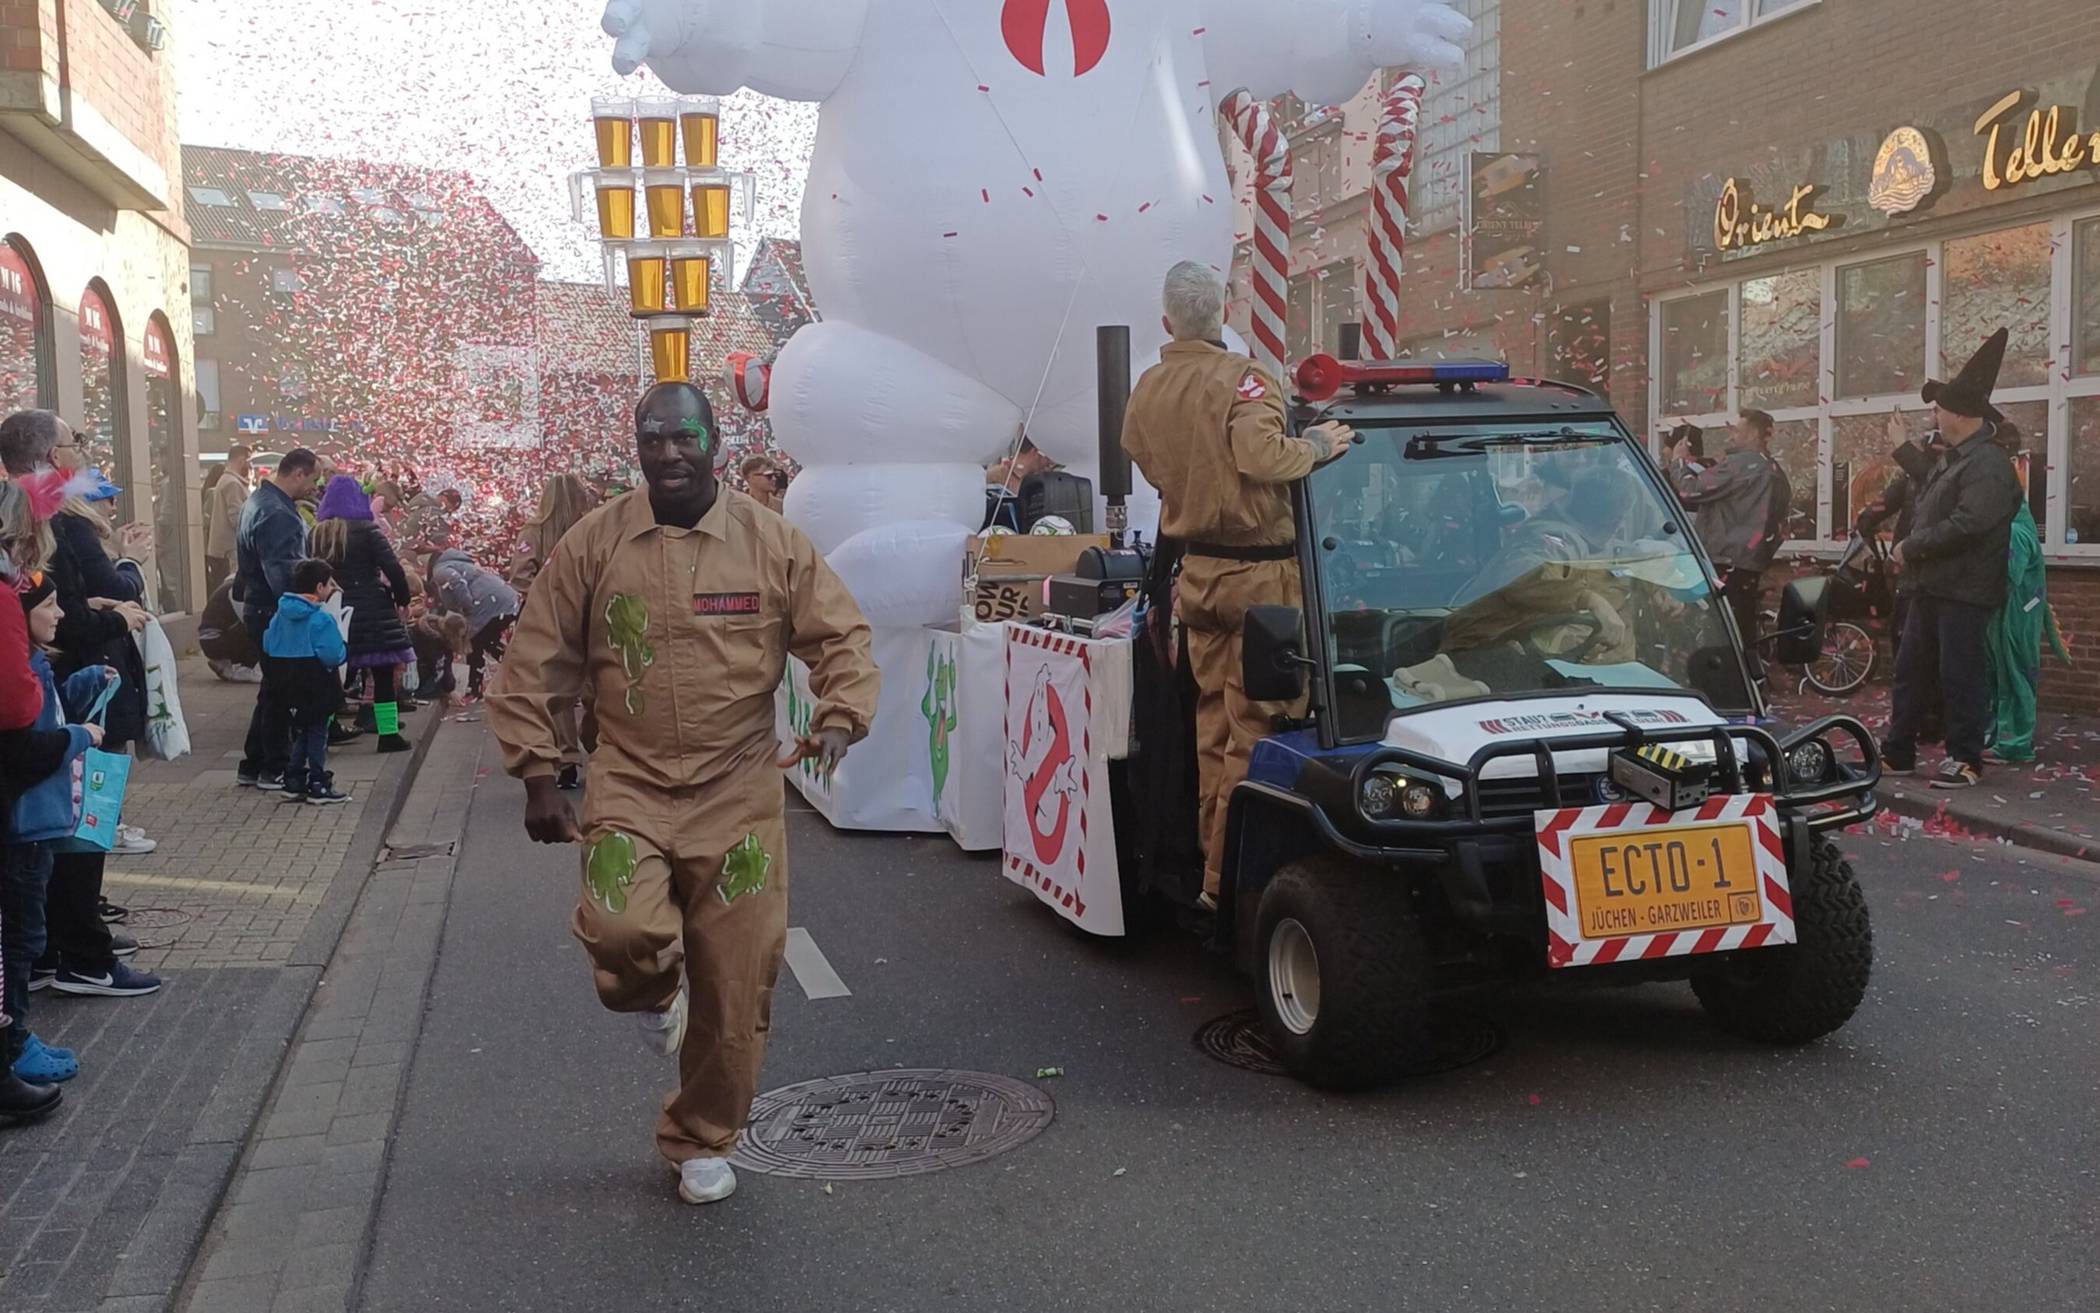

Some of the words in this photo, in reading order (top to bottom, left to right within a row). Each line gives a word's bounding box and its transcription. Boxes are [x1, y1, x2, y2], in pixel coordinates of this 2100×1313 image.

[1714, 177, 1829, 251] Orient
[693, 596, 759, 611] MOHAMMED
[1502, 714, 1546, 726] STAU?
[1511, 719, 1609, 732] RETTUNGSGASS
[1592, 906, 1637, 930] JÜCHEN
[1647, 900, 1722, 924] GARZWEILER
